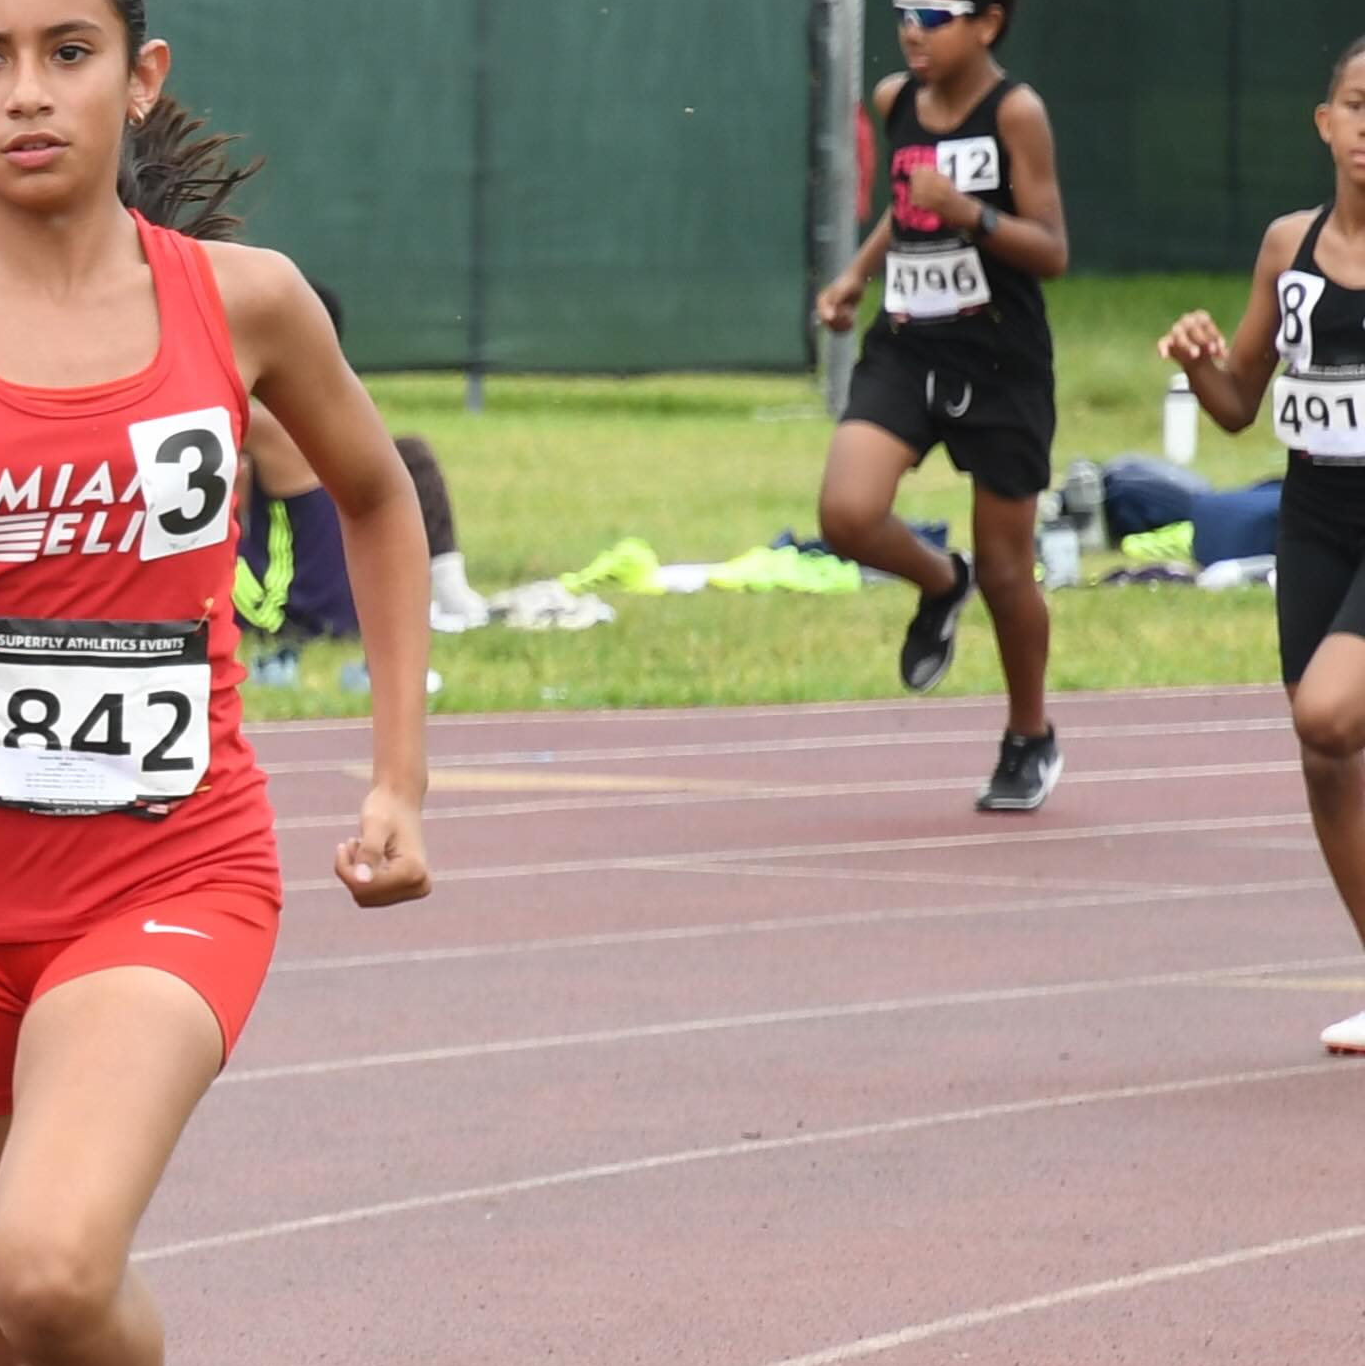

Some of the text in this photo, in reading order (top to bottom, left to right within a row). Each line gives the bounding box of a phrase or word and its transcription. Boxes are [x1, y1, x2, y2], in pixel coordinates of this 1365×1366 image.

[1283, 282, 1308, 344] 8
[155, 428, 228, 535] 3
[42, 510, 146, 556] ELI
[66, 636, 137, 651] ATHLETICS
[139, 637, 185, 651] EVENTS
